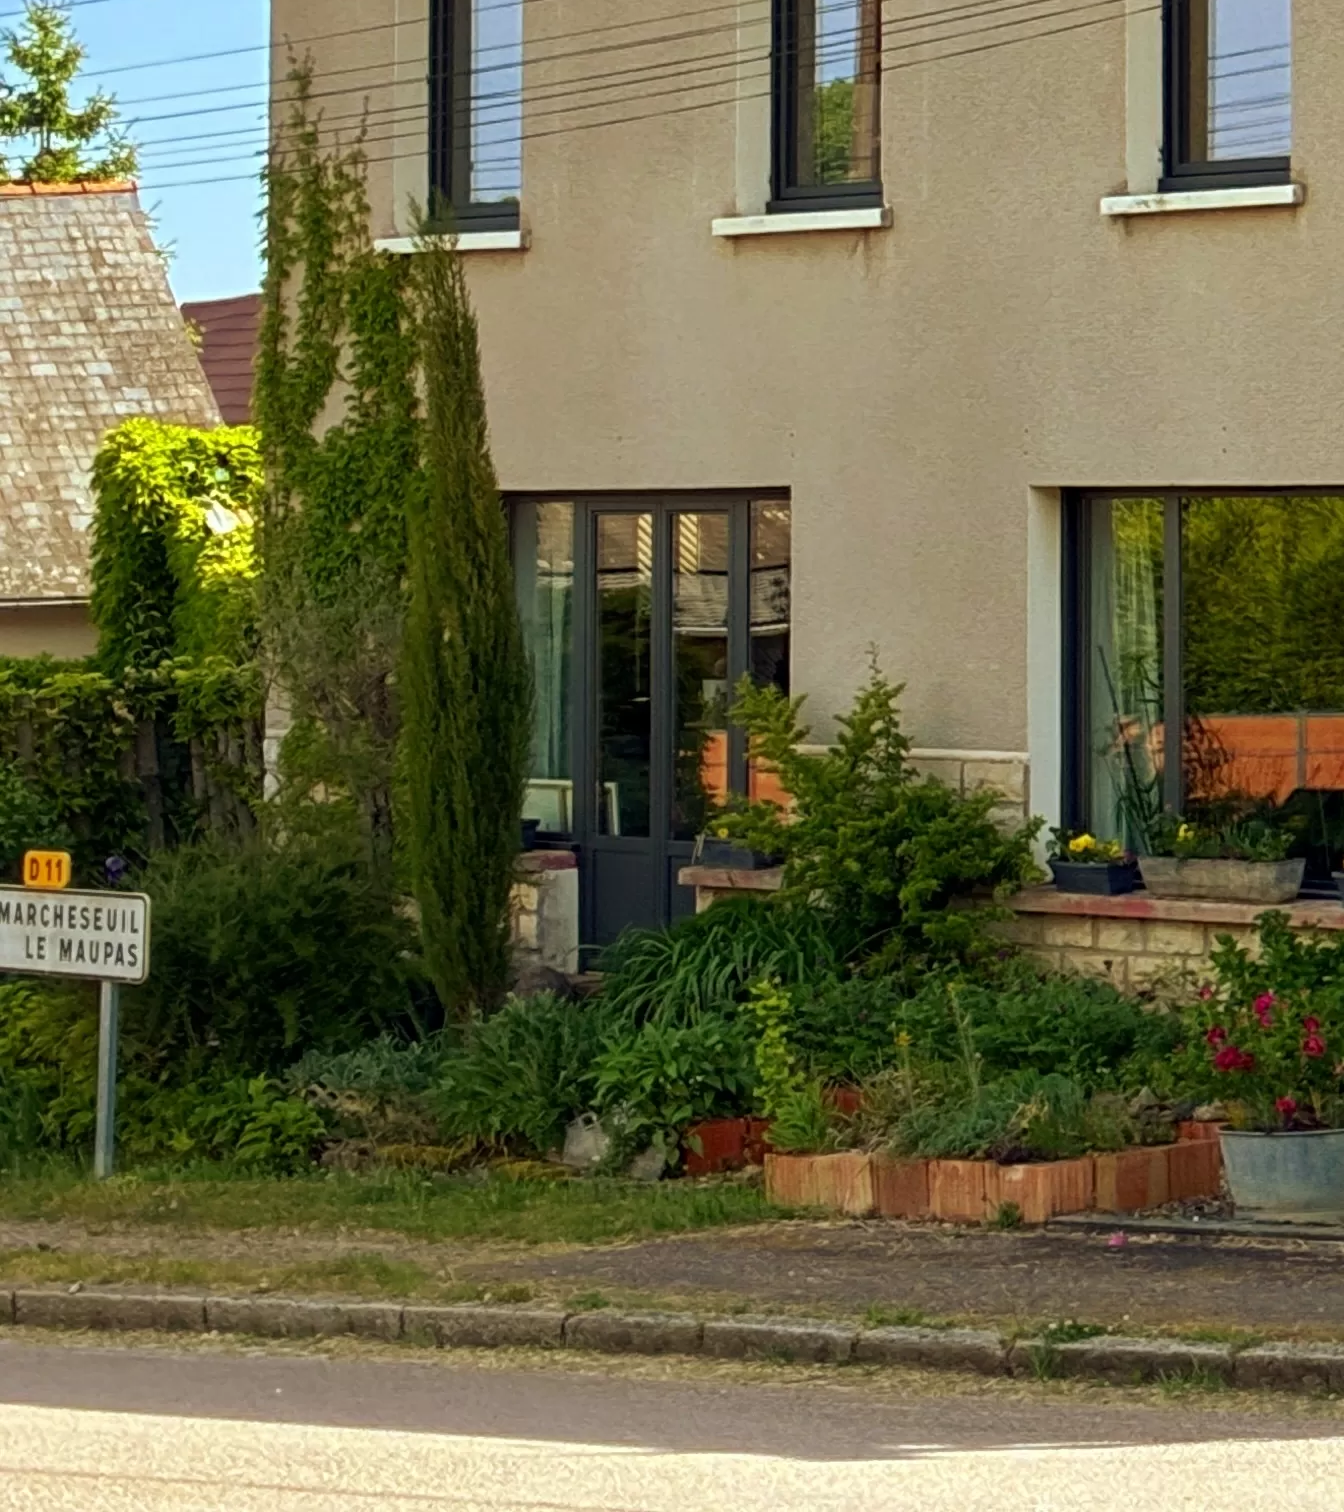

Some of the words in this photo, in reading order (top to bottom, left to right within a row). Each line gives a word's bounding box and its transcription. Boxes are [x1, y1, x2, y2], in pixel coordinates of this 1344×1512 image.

[30, 858, 40, 881] D
[45, 858, 62, 883] 11
[0, 901, 139, 934] MARCHESEUIL
[25, 936, 46, 960] LE
[60, 938, 138, 967] MAUPAS
